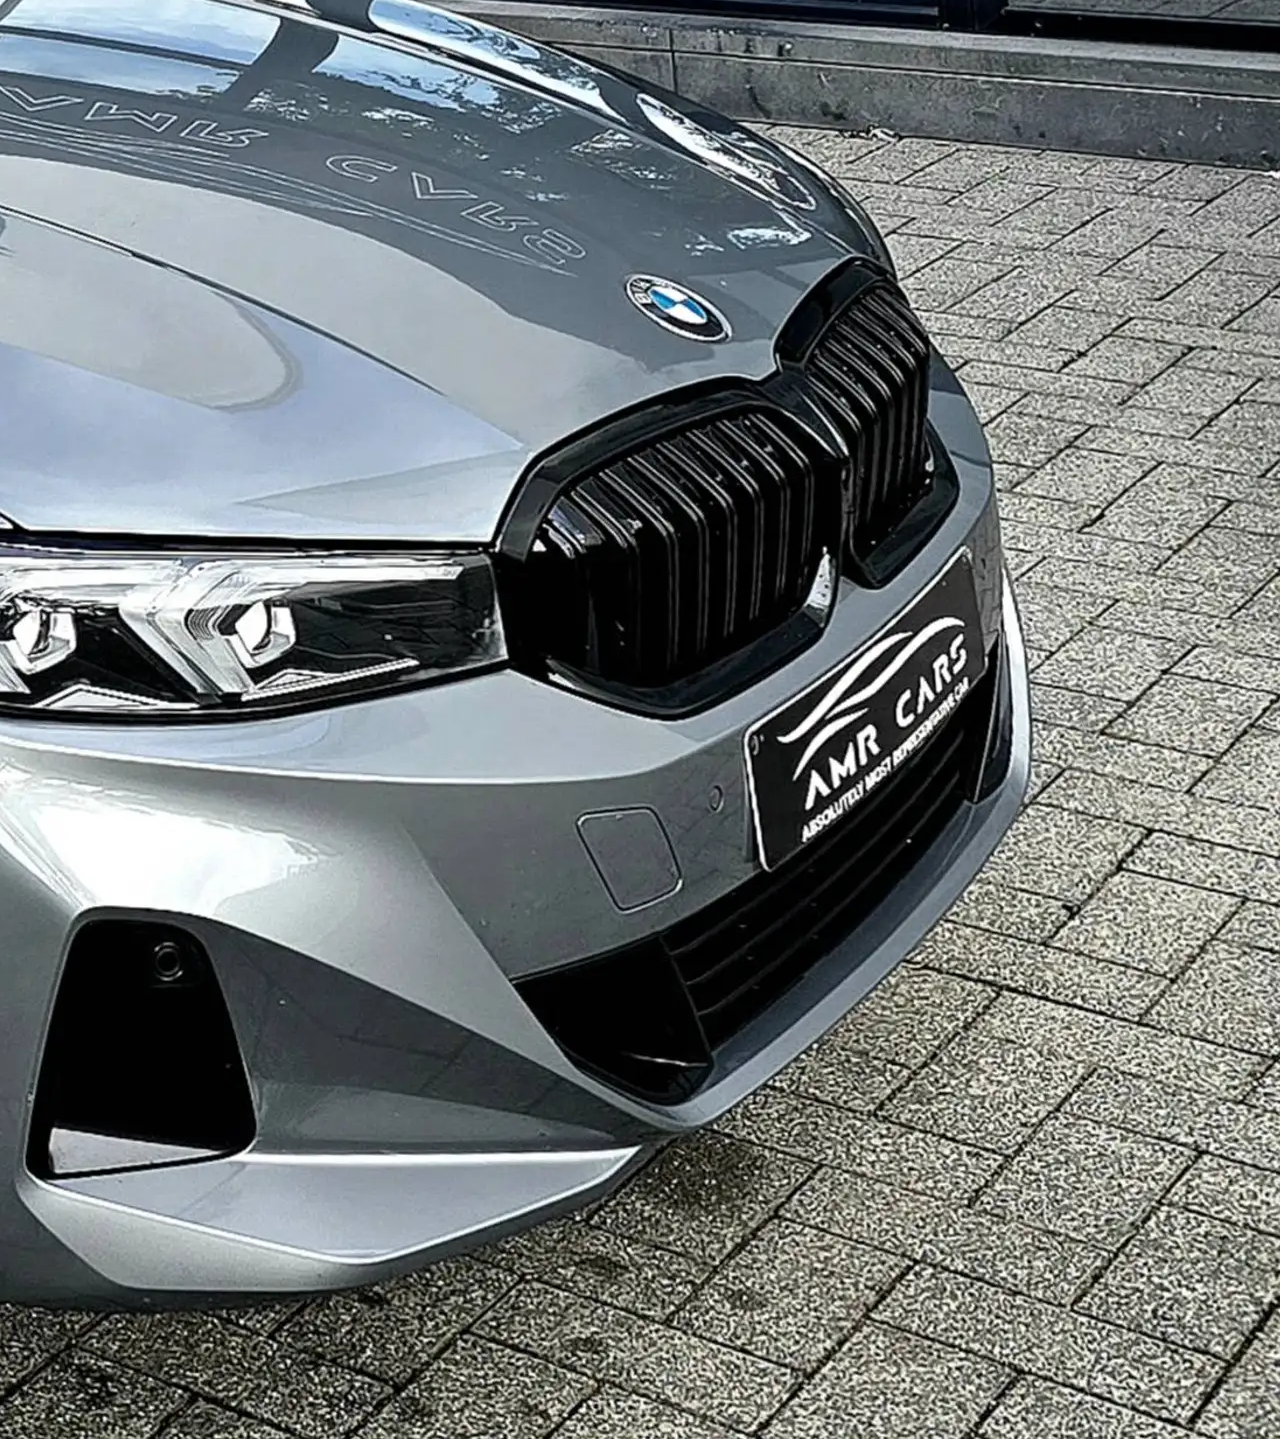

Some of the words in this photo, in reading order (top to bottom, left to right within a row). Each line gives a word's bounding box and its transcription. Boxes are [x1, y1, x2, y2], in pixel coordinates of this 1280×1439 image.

[804, 723, 881, 811] AMR
[895, 632, 967, 729] CARS
[864, 756, 892, 792] MOST
